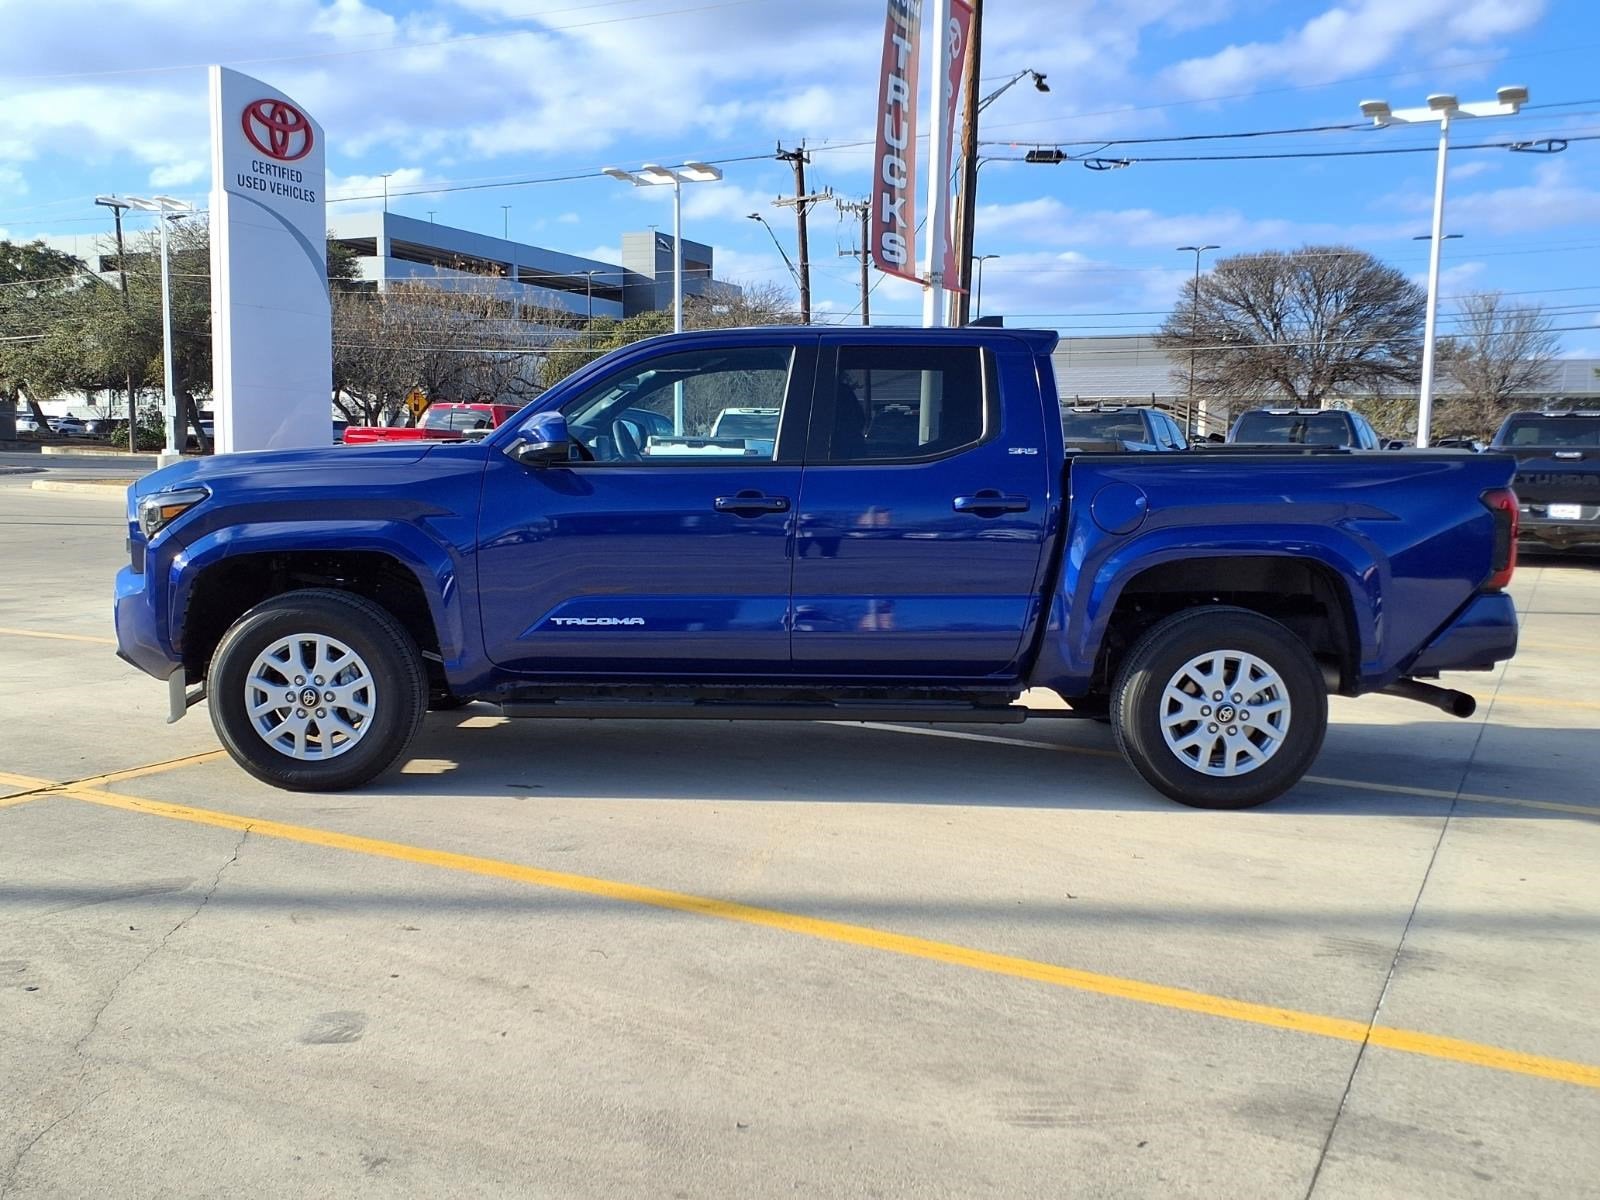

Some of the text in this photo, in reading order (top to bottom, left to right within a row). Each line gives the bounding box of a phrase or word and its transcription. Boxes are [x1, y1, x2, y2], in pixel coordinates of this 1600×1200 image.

[881, 33, 912, 265] TRUCKS
[252, 160, 303, 183] CERTIFIED
[237, 174, 316, 203] USED VEHICLES
[550, 617, 645, 626] TACOMA
